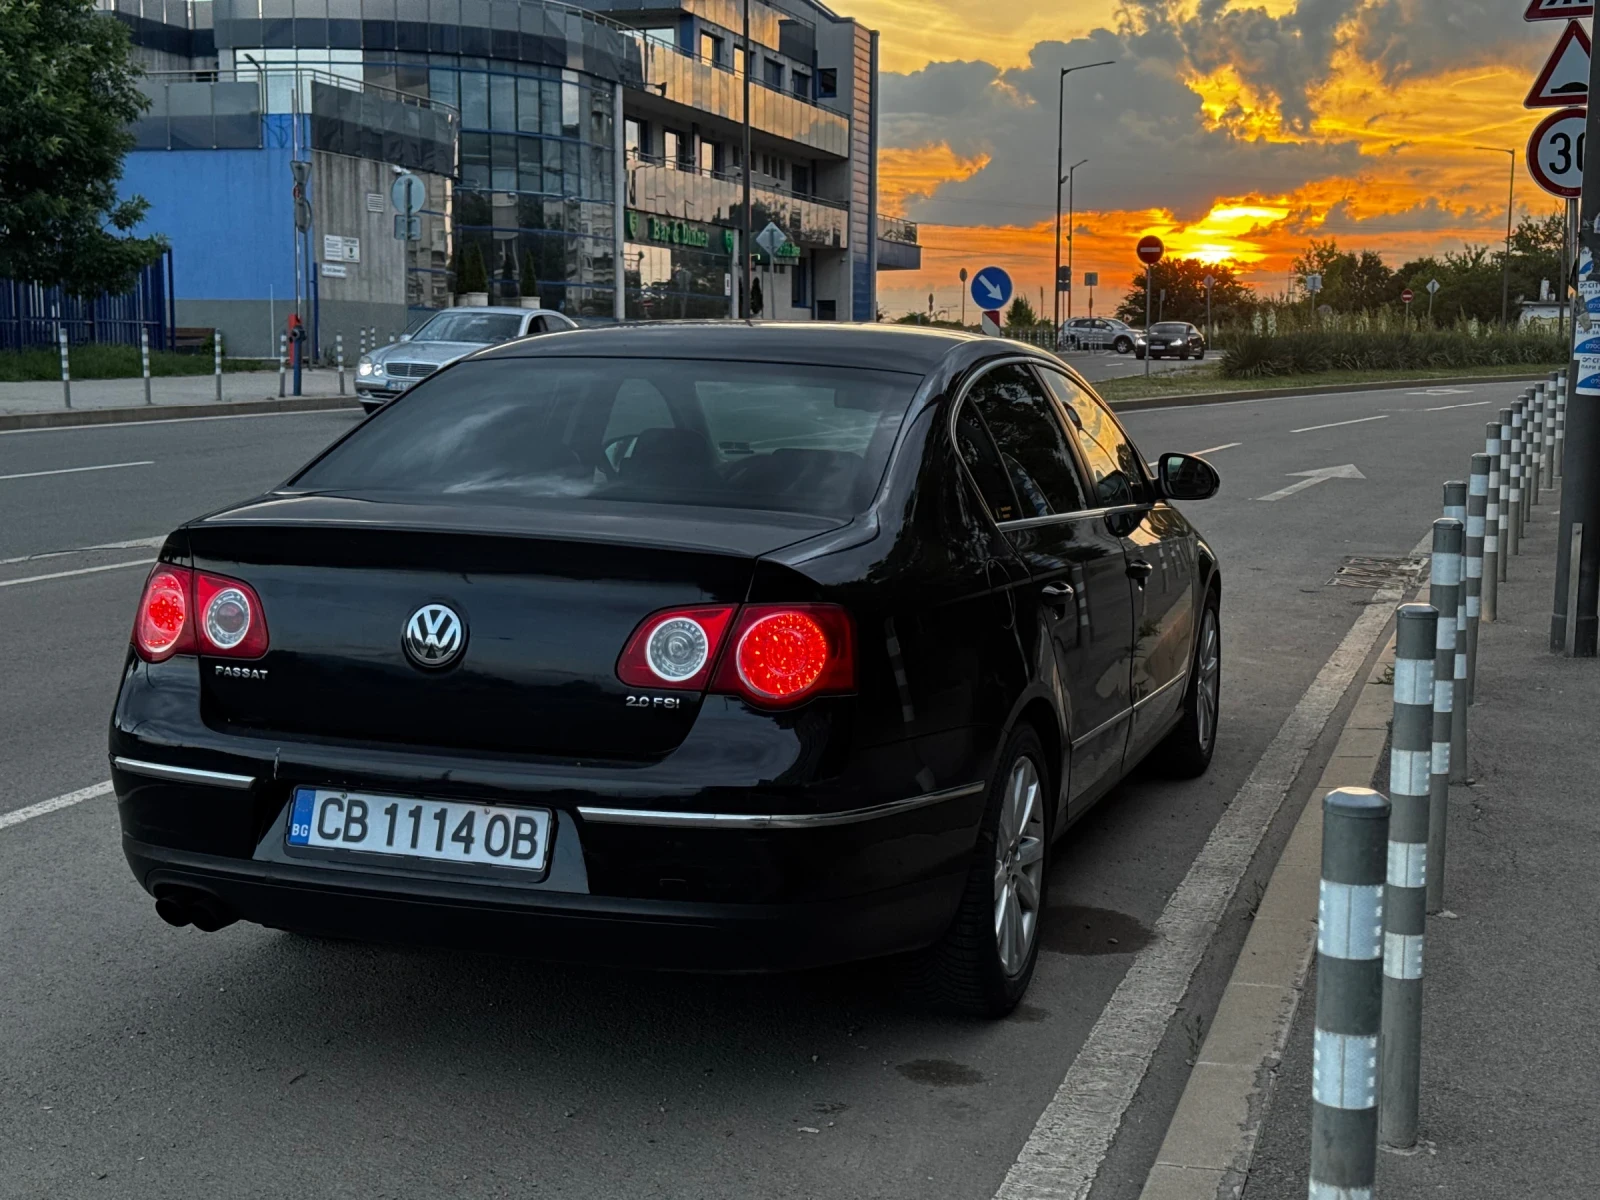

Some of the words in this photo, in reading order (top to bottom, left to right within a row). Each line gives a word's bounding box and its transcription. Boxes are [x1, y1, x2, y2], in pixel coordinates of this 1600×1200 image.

[653, 218, 671, 241] Bar
[673, 221, 681, 244] &
[682, 223, 710, 247] Dinner
[407, 604, 461, 664] VW
[215, 665, 268, 680] PASSAT
[653, 697, 680, 709] FSI
[291, 823, 309, 837] BG
[317, 797, 369, 843] CB
[384, 802, 476, 854] 1114
